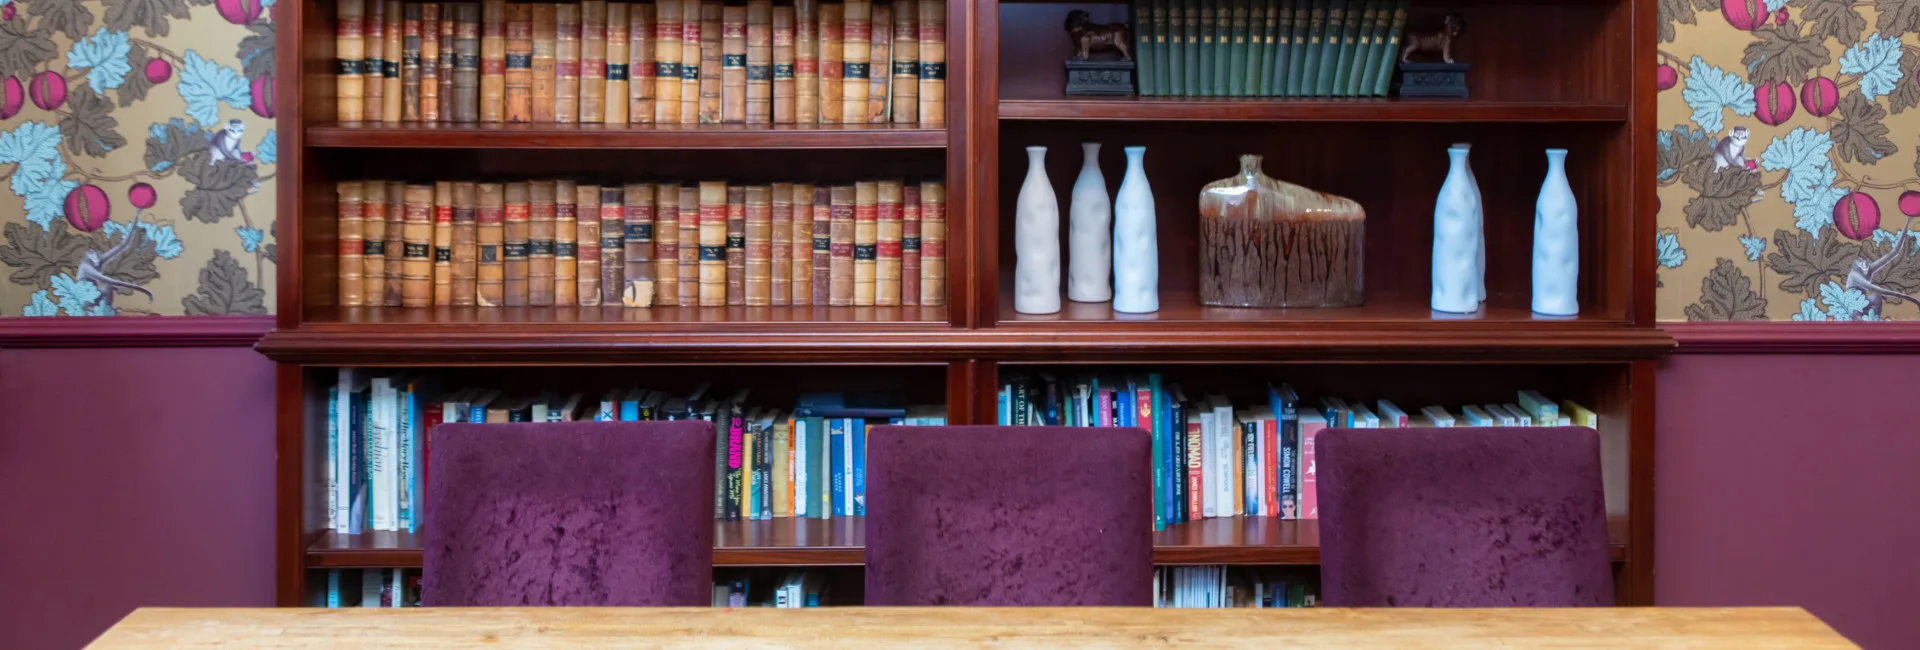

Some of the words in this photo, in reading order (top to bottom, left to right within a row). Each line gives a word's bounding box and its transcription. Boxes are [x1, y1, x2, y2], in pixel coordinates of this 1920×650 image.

[728, 427, 742, 469] BRAND
[1188, 434, 1200, 468] NOMAD
[1283, 447, 1291, 468] SIMON
[1283, 469, 1291, 493] COWELL
